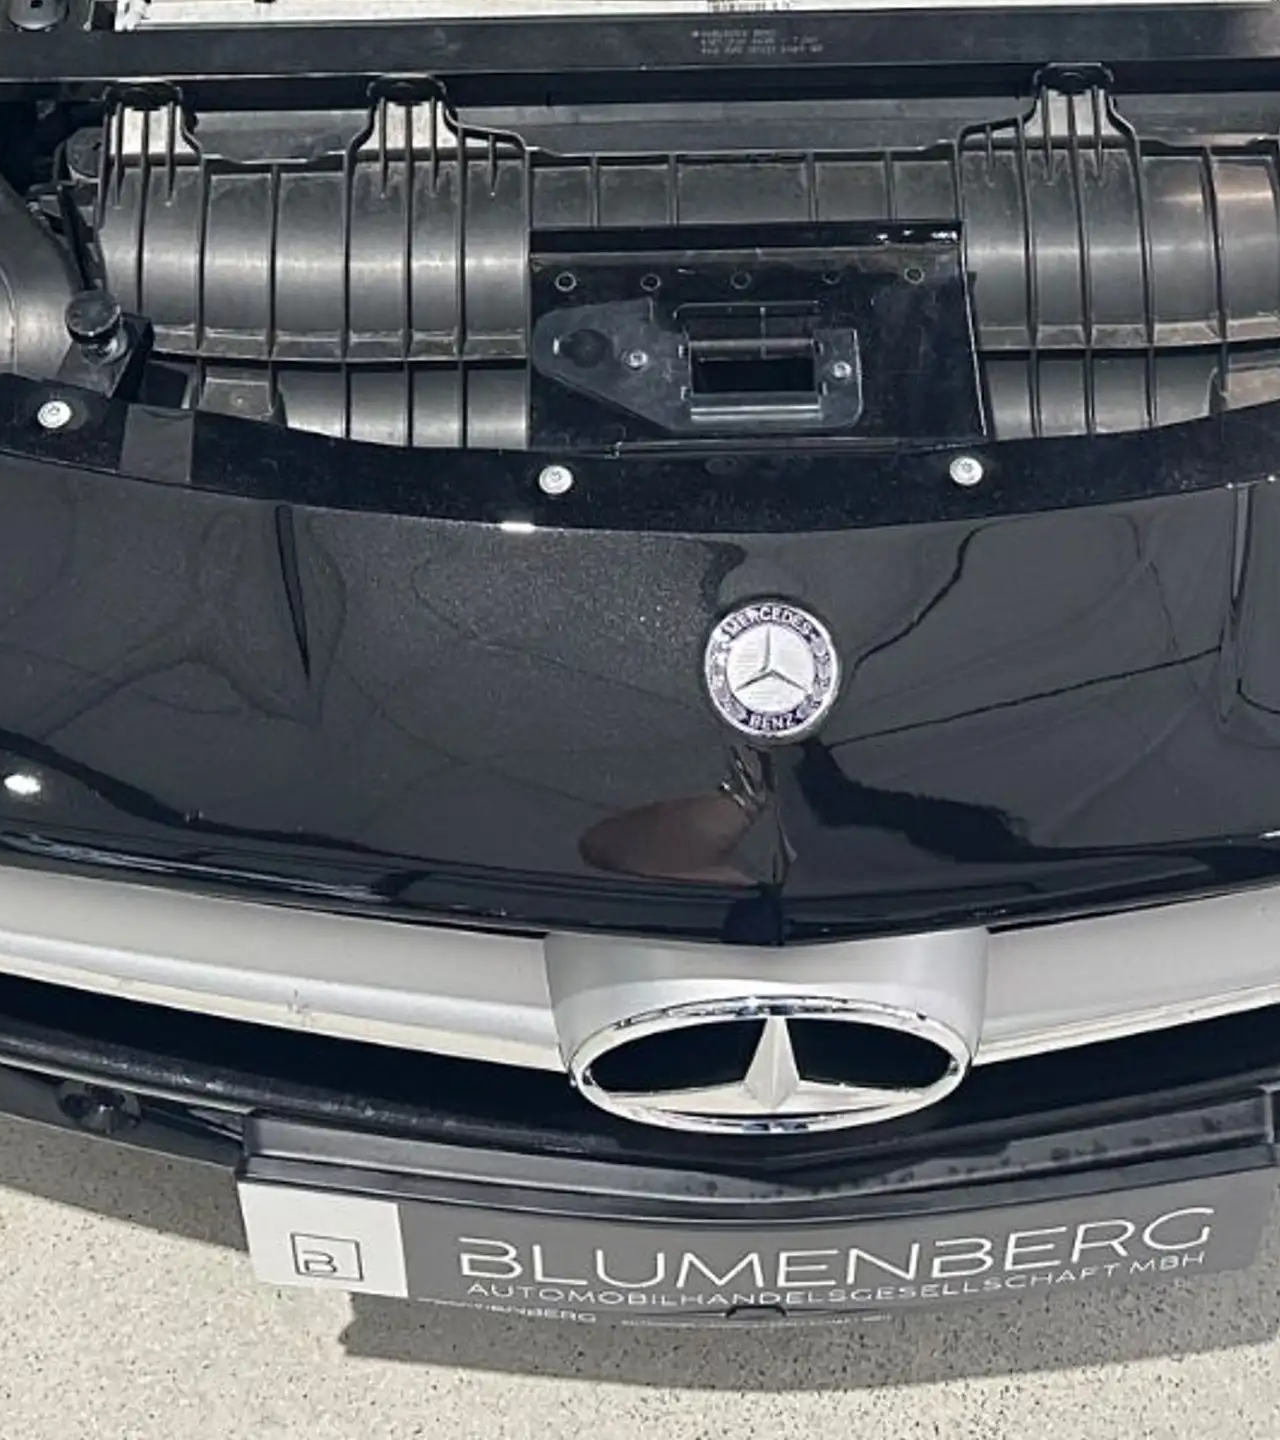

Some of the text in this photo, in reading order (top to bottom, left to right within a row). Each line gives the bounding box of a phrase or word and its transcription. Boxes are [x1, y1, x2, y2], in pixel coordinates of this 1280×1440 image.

[722, 607, 812, 637] MERCEDES
[749, 711, 797, 730] BENZ
[458, 1207, 1215, 1289] BLUMENBERG
[467, 1250, 1206, 1307] AUTOMOBILHANDELSGESELLSCHAFT MBH
